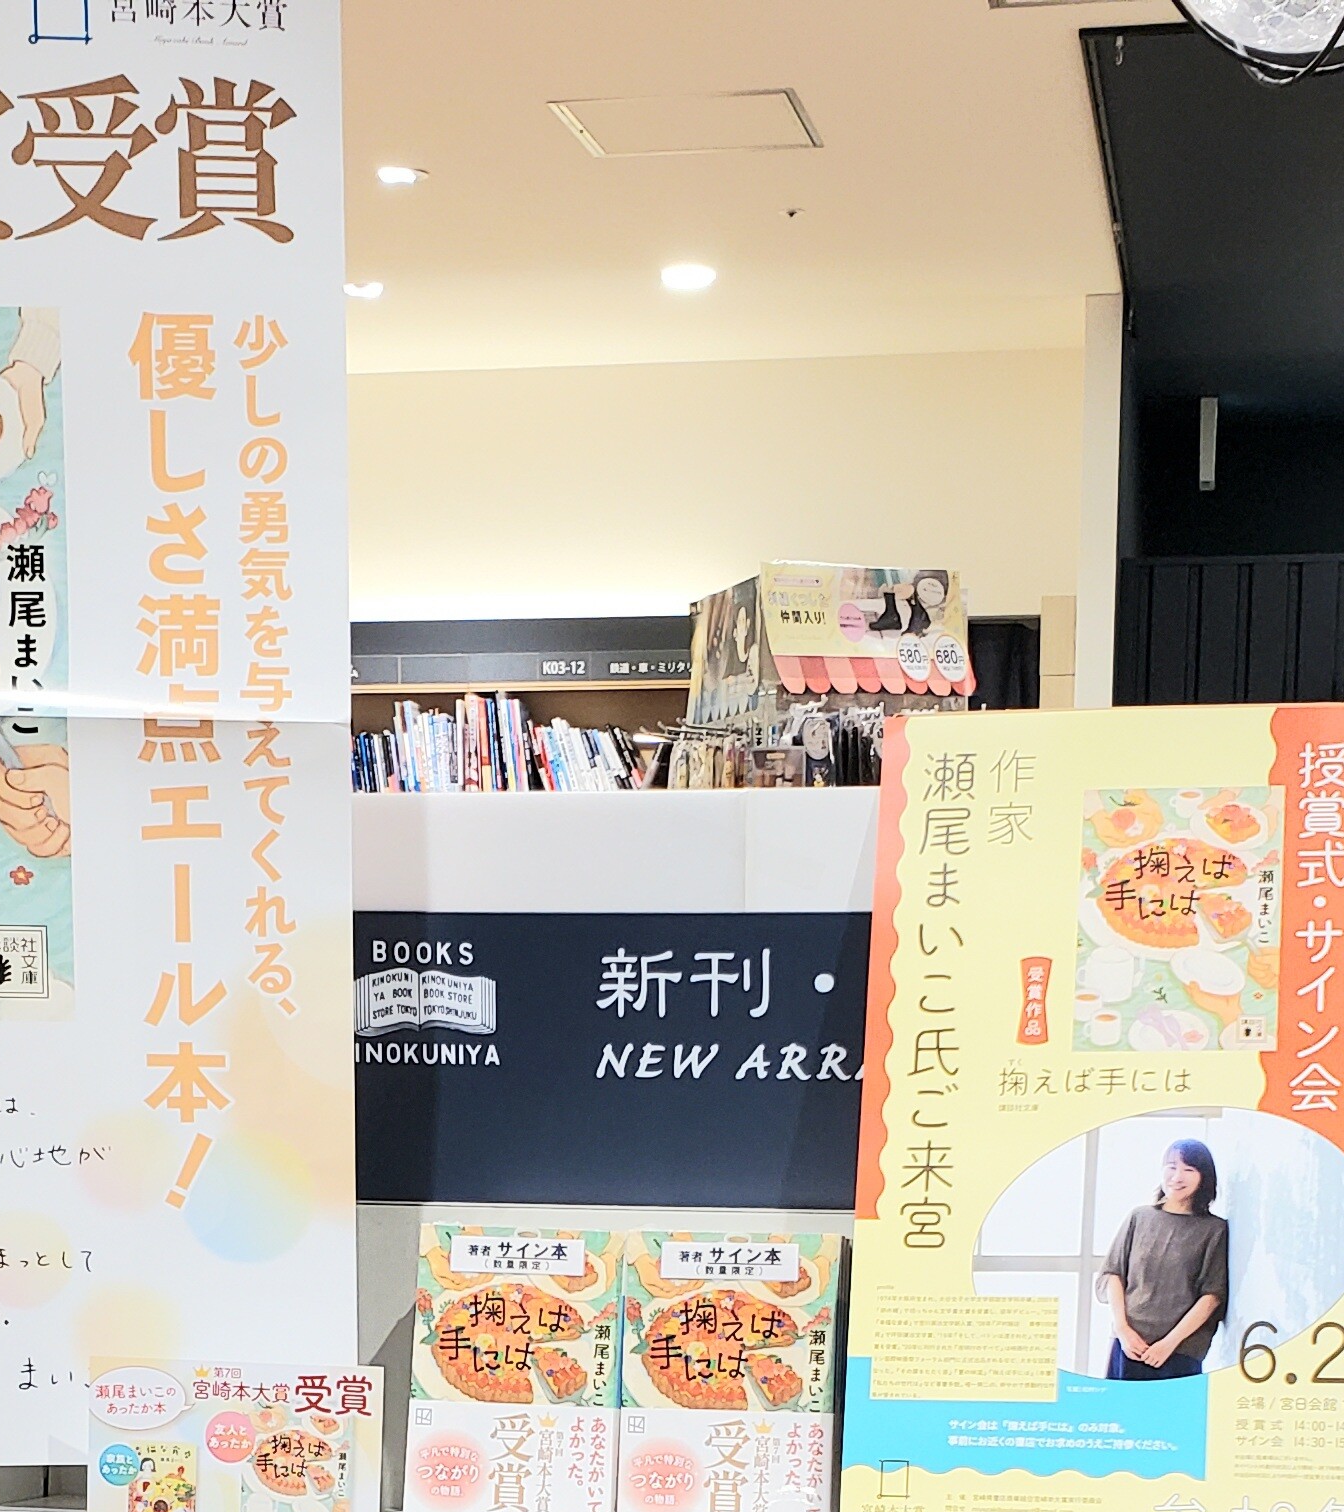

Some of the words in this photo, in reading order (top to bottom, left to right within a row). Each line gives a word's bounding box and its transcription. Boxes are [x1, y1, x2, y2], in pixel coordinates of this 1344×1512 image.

[6, 544, 46, 735] 瀬尾まいこ
[232, 314, 298, 1018] 少しの勇気を与えてくれる、
[542, 660, 585, 675] K03-12
[987, 749, 1037, 846] 作家
[1134, 848, 1232, 883] 掬えば
[1106, 880, 1200, 920] 手には
[372, 940, 474, 965] BOOKS
[899, 751, 975, 1250] 瀬尾まいこ氏ご来宮
[1024, 966, 1045, 1037] 受賞作品
[596, 1043, 720, 1080] NEW
[998, 1067, 1192, 1097] 掬えば手には
[496, 1242, 569, 1262] サイン本
[468, 1295, 571, 1335] 掬えば
[439, 1326, 535, 1373] 手には
[593, 1324, 612, 1406] 瀬尾まいこ
[95, 1384, 176, 1399] 瀬尾まいこの
[107, 1401, 166, 1414] あったか本
[193, 1380, 290, 1404] 宮崎本大賞
[294, 1375, 374, 1416] 受賞
[567, 1416, 587, 1488] よかった。
[416, 1462, 481, 1483] つながり
